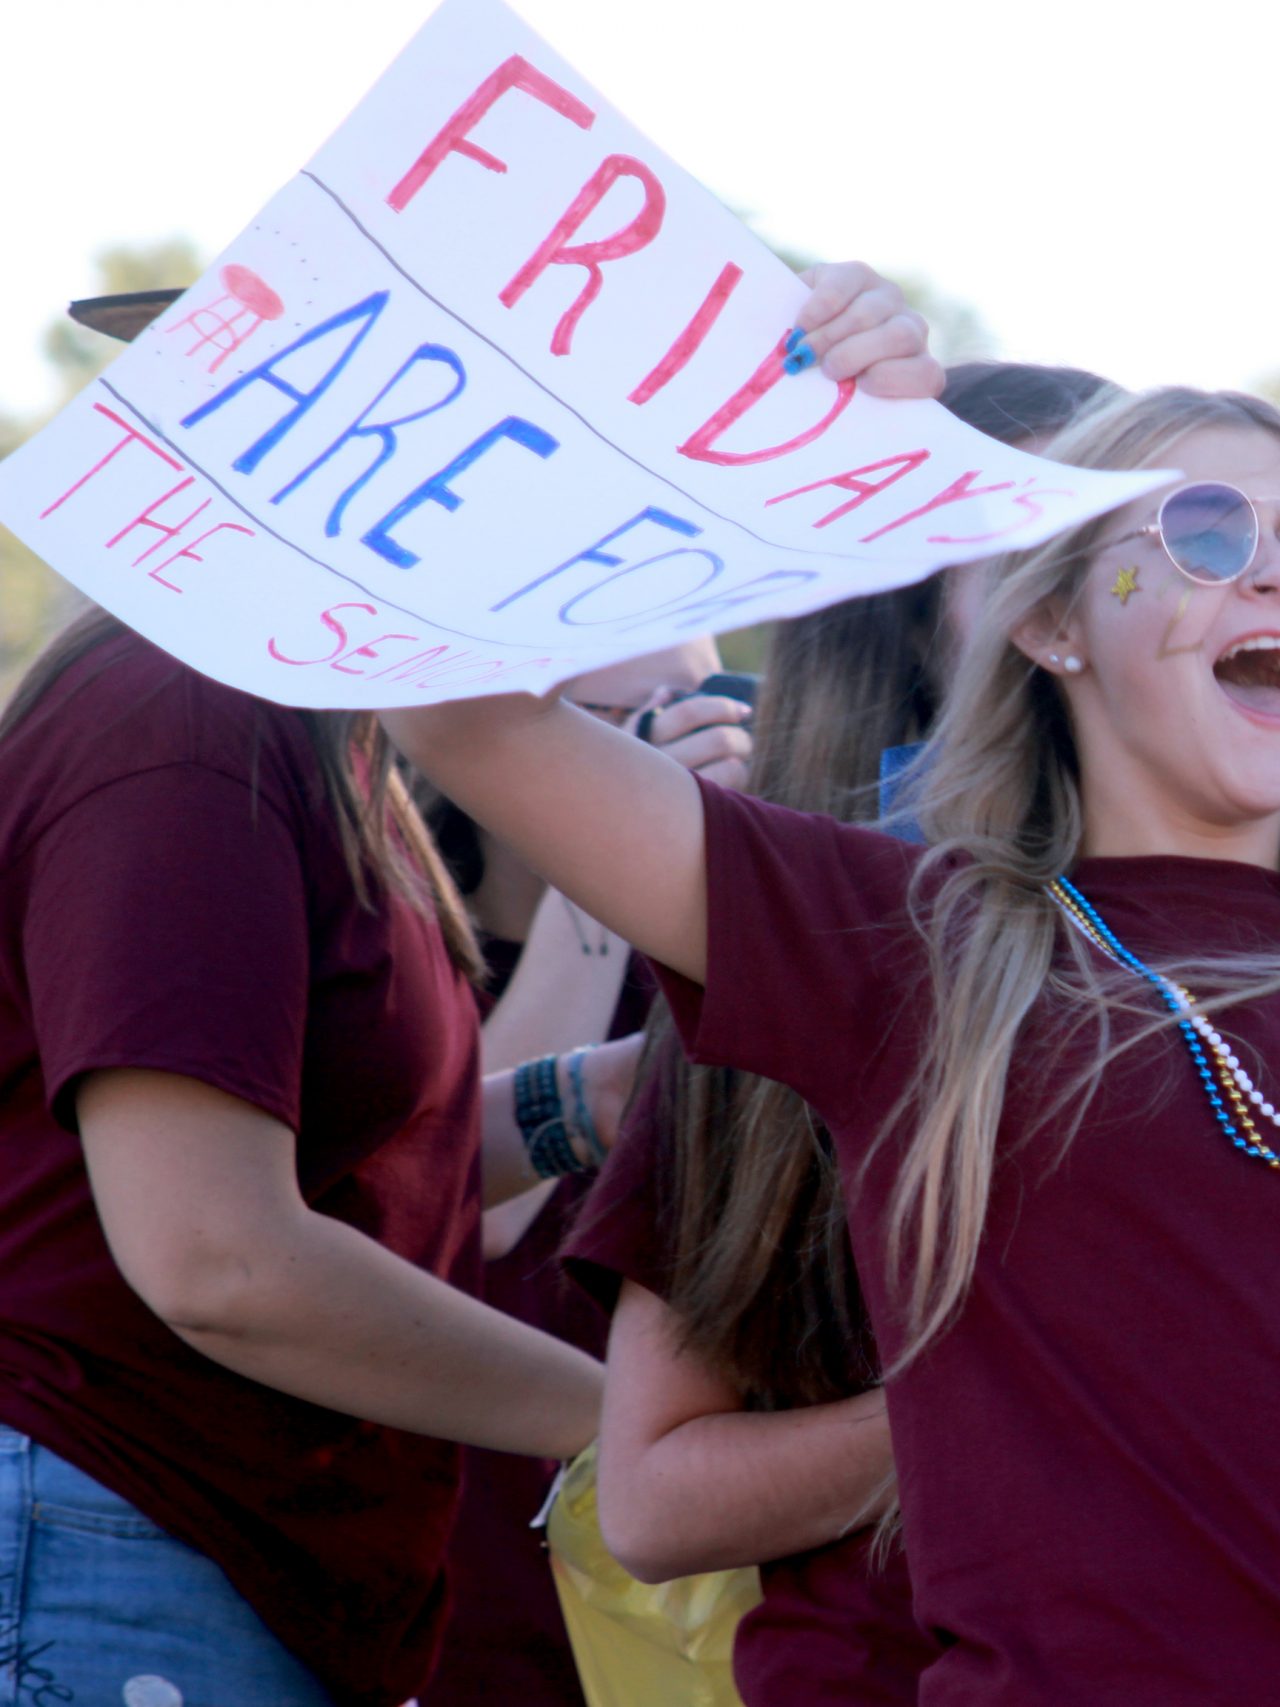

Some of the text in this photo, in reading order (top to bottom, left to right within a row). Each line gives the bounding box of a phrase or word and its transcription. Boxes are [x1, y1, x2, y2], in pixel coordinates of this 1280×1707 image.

[39, 403, 255, 593] THE
[180, 290, 820, 633] ARE FOR
